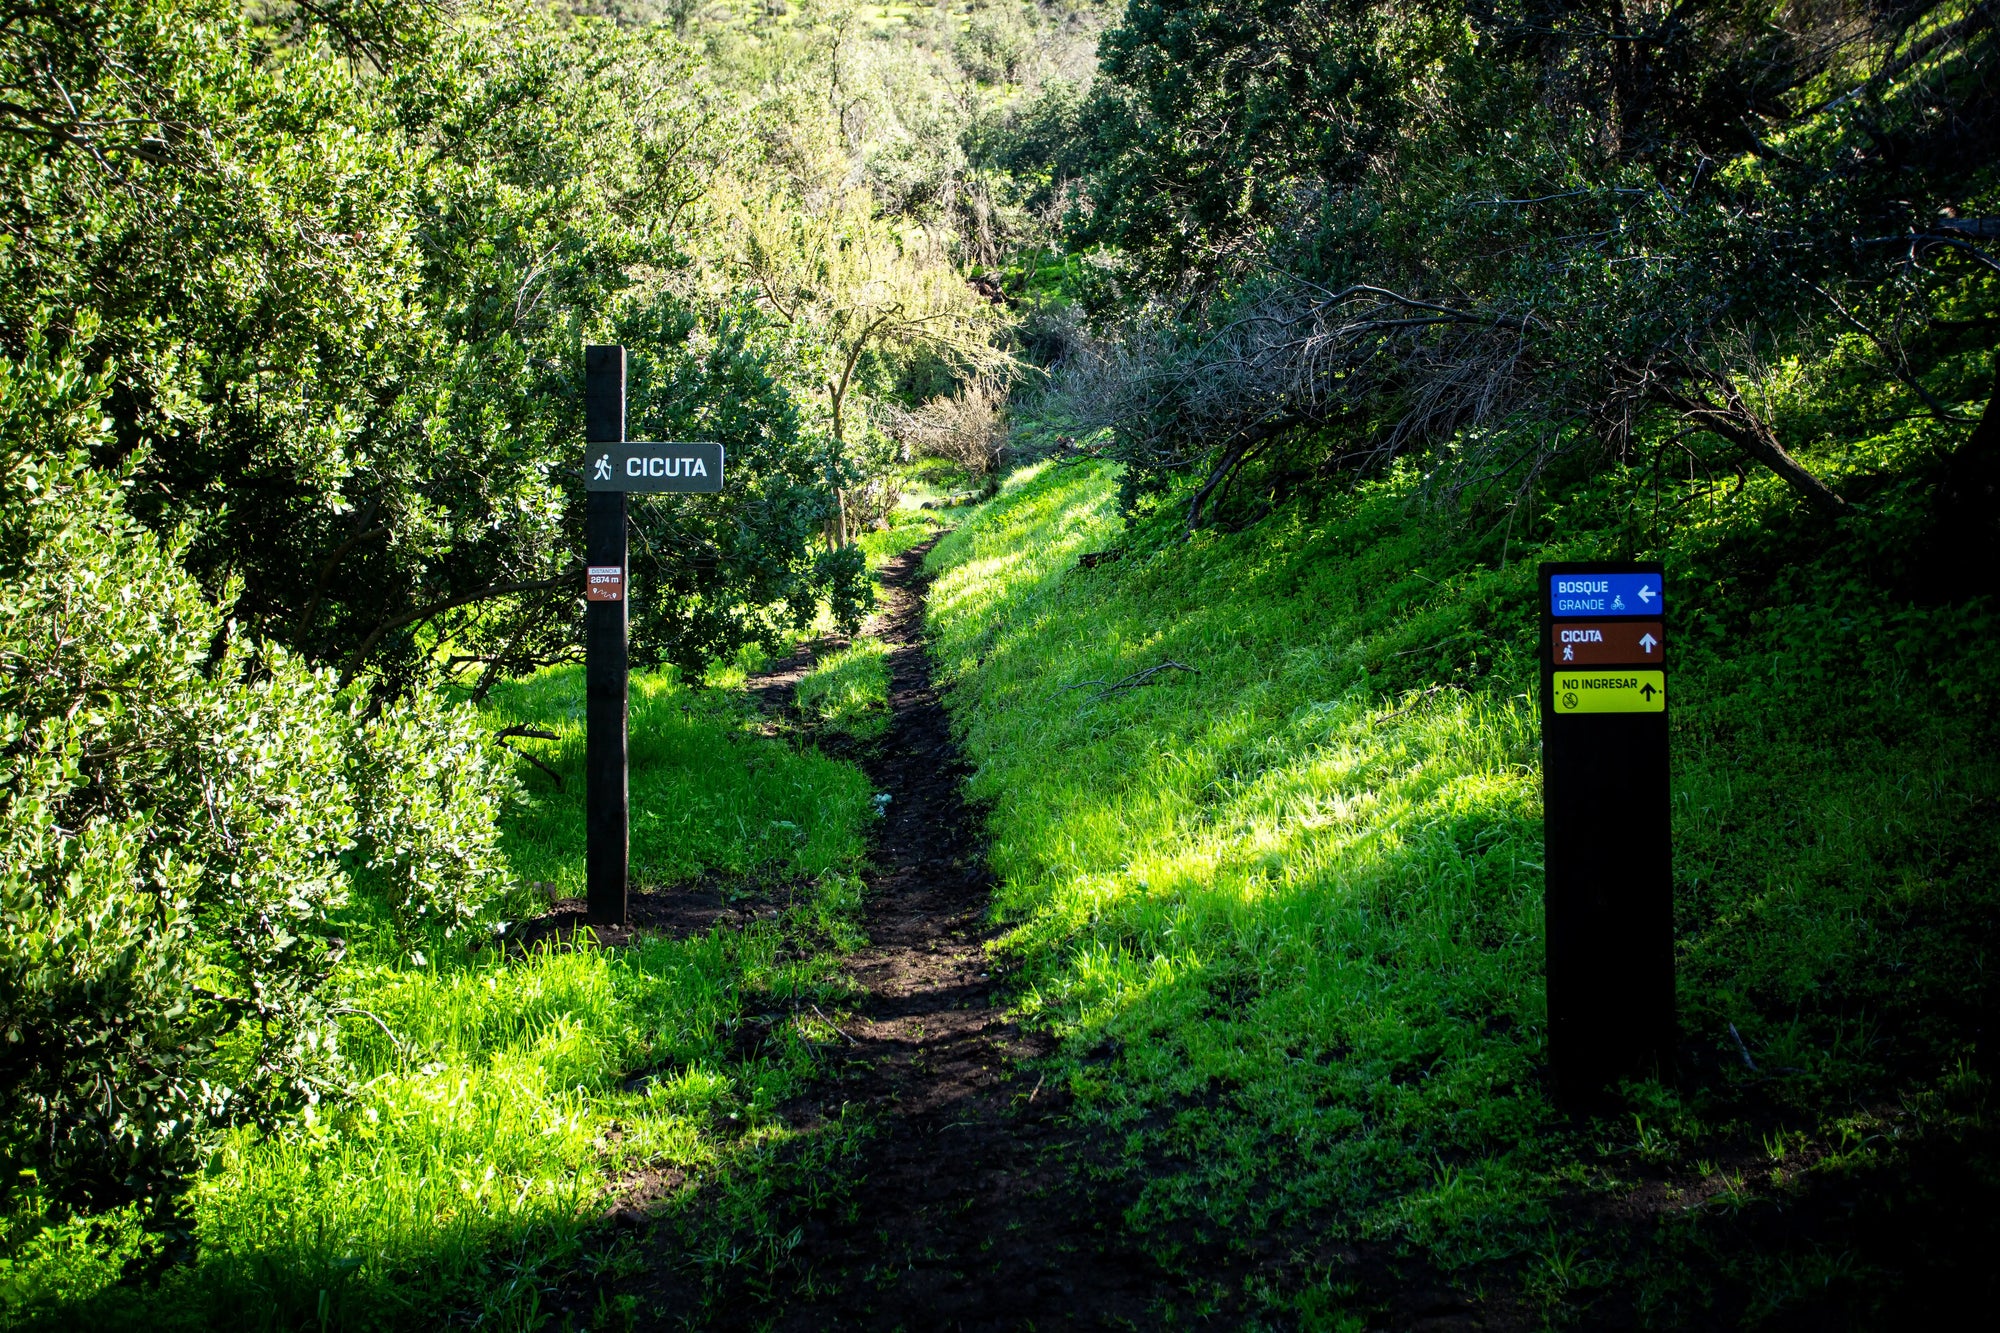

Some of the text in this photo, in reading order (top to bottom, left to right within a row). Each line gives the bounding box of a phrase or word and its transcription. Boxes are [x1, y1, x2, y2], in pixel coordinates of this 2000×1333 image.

[626, 457, 707, 477] CICUTA
[1558, 581, 1608, 595] BOSQUE
[1558, 599, 1605, 610] GRANDE
[1561, 630, 1602, 642] CICUTA
[1562, 678, 1638, 689] NO INGRESAR
